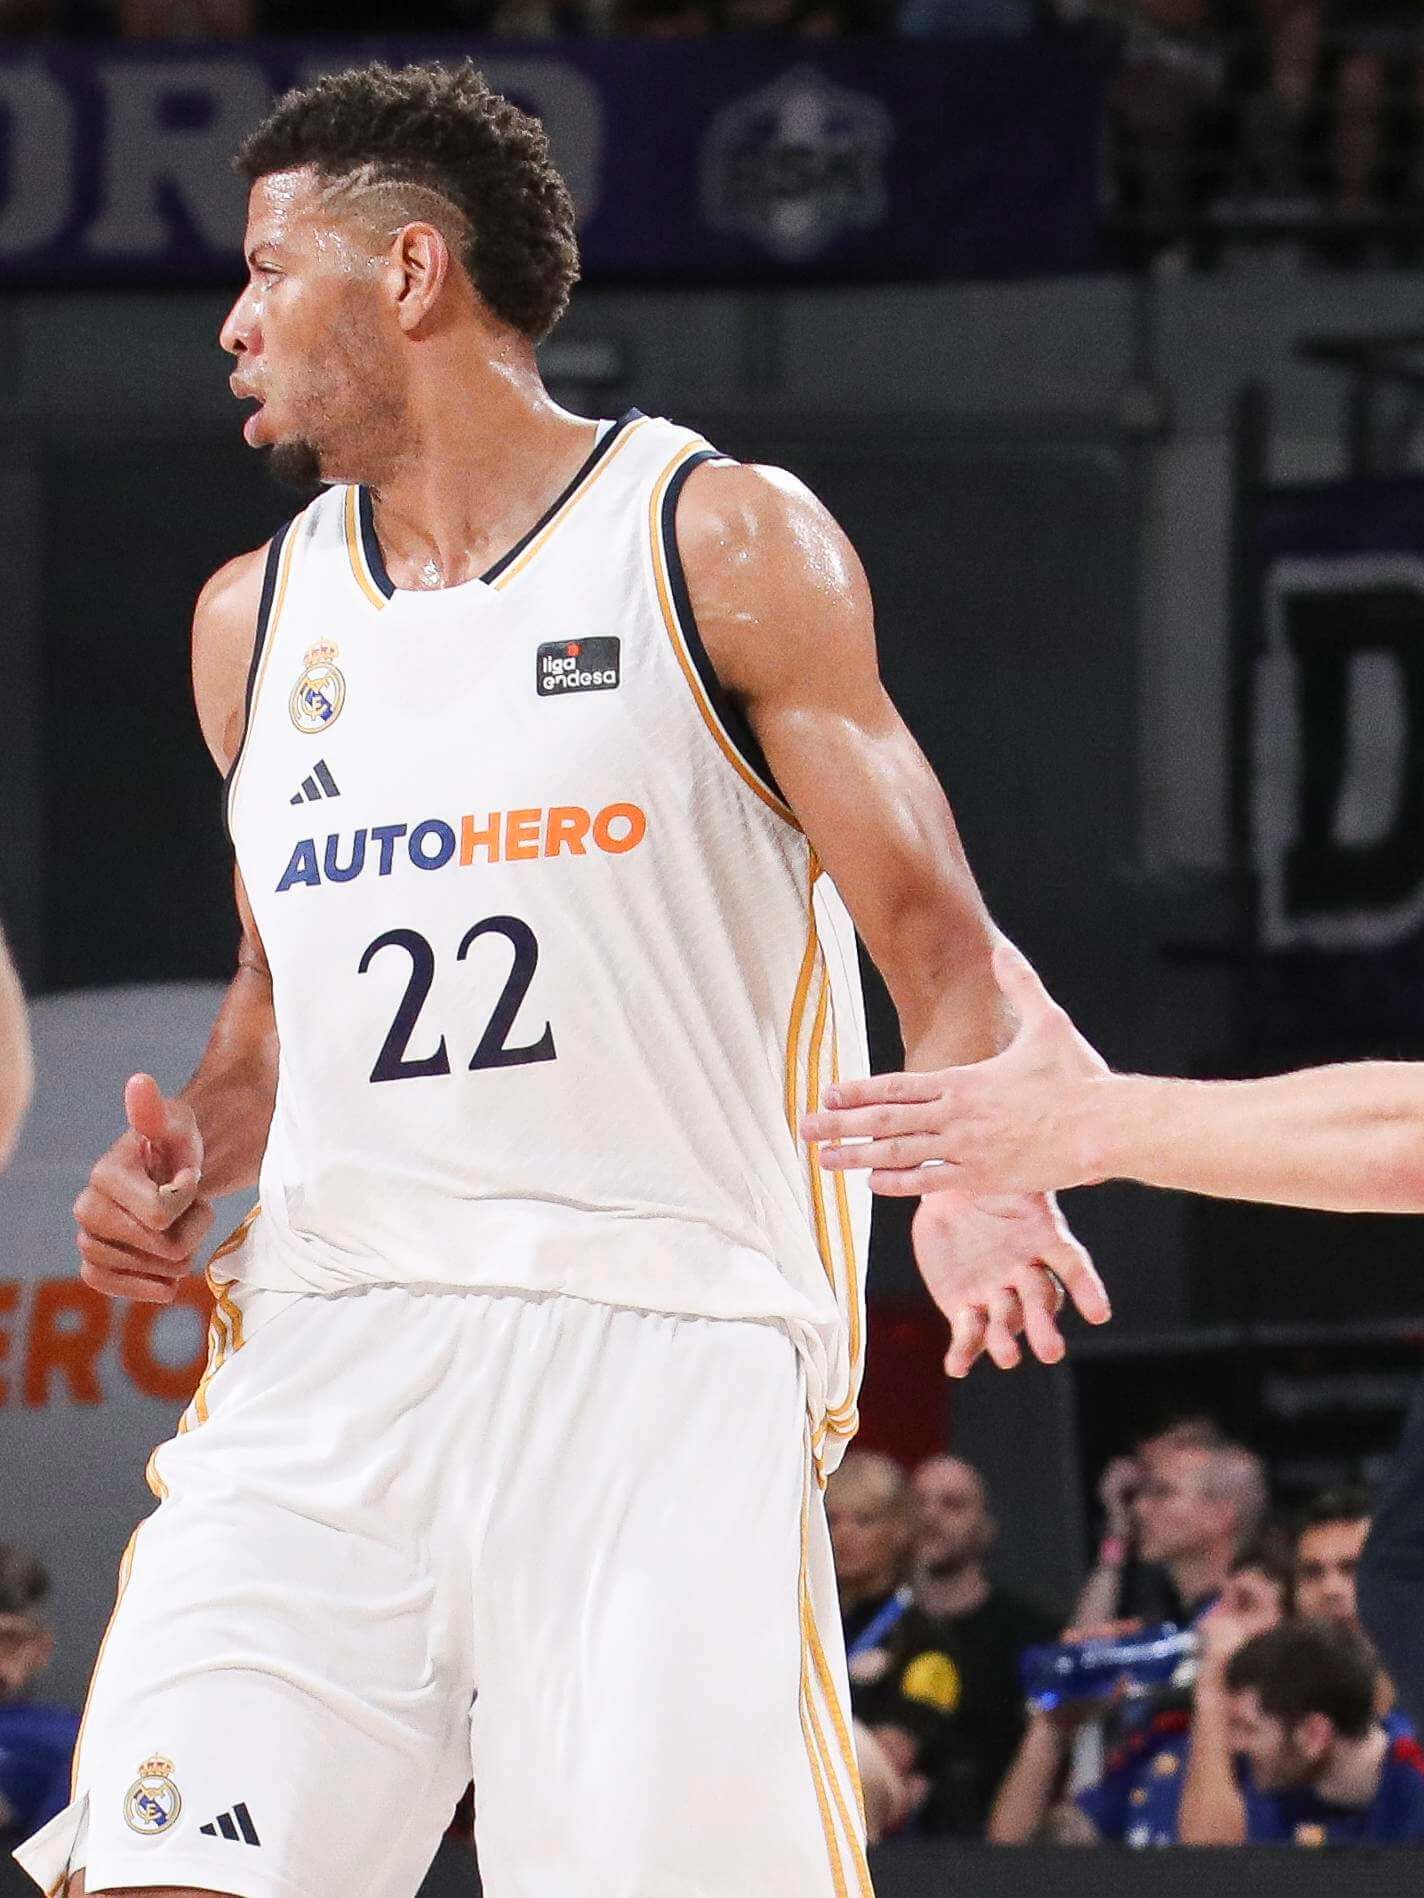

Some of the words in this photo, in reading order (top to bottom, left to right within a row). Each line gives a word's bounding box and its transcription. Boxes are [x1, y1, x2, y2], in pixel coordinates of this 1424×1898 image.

[543, 656, 576, 675] liga
[543, 670, 617, 690] endesa
[275, 803, 646, 892] AUTOHERO
[357, 915, 557, 1083] 22
